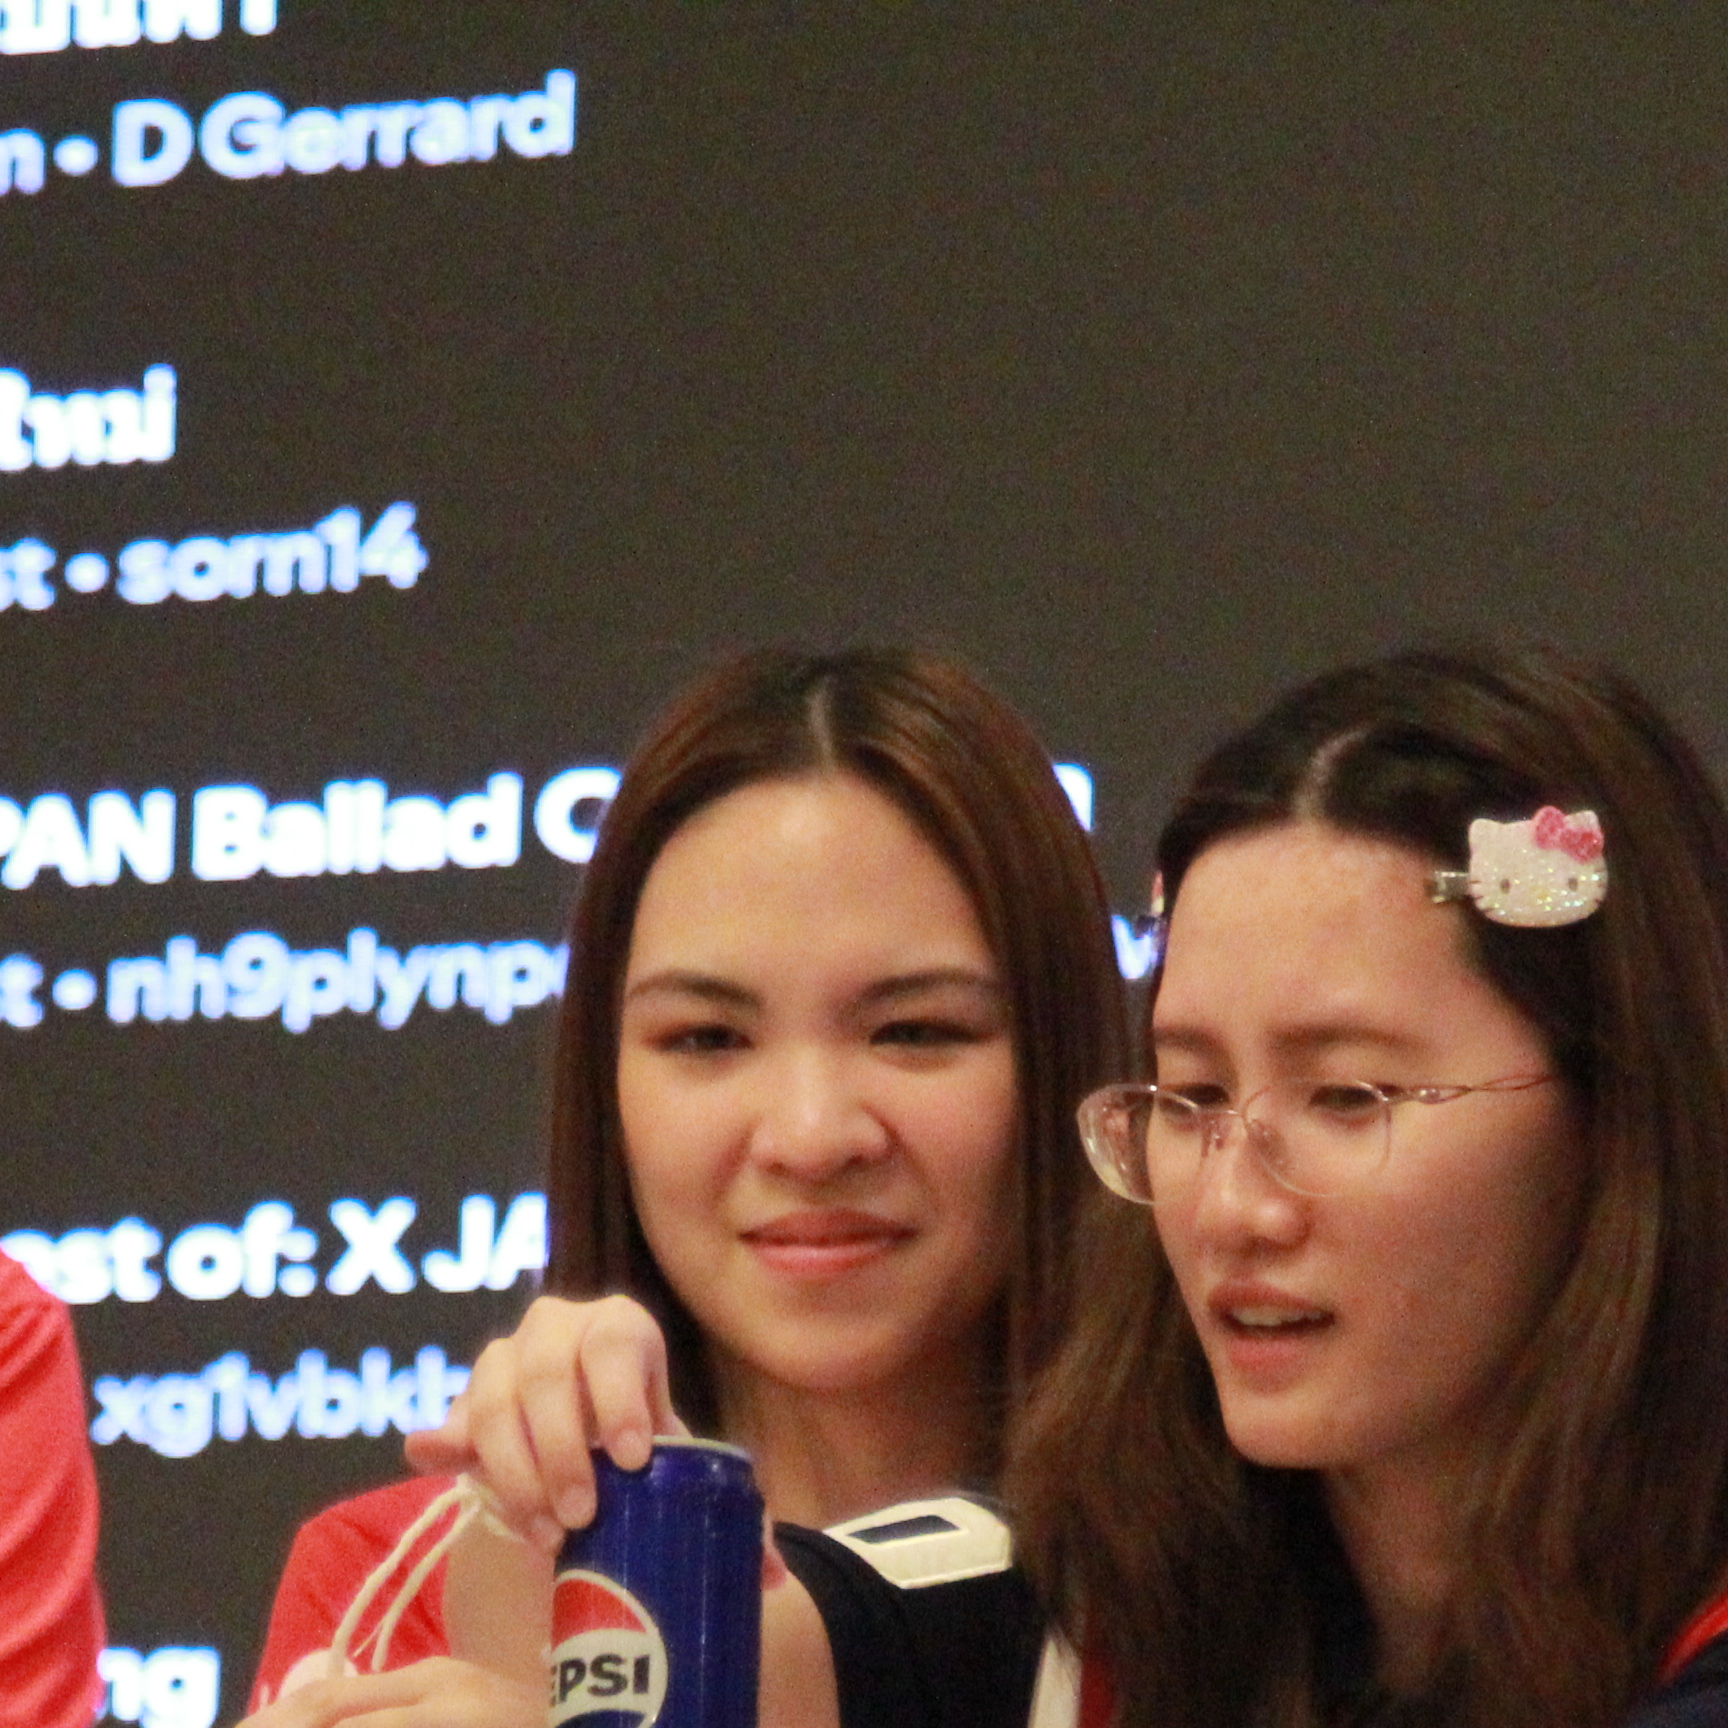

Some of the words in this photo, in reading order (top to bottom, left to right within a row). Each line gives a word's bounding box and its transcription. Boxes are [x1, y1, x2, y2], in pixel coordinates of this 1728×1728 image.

[112, 99, 193, 187] D
[199, 69, 576, 180] Gerrard
[190, 771, 524, 881] Ballad
[325, 1196, 418, 1295] X
